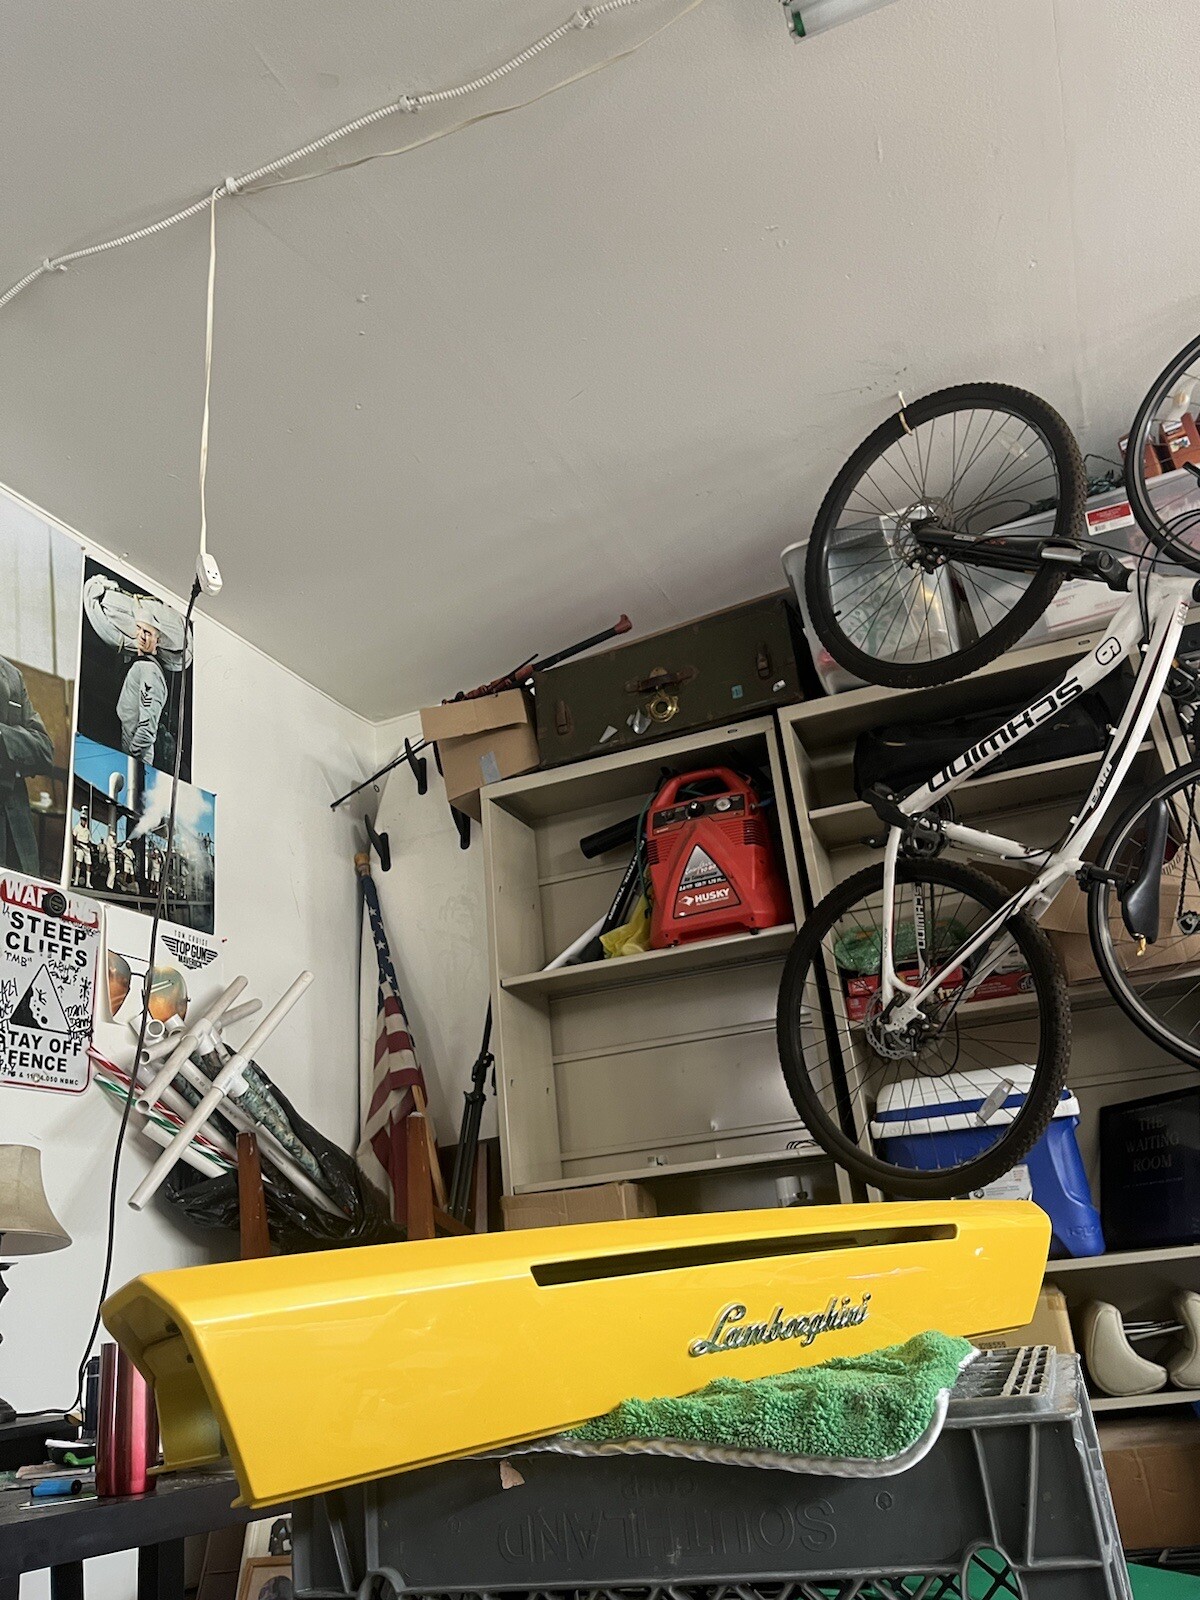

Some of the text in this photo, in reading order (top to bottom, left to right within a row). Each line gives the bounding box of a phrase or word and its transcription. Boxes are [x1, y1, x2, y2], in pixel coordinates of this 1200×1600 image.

[928, 676, 1083, 793] SCHWINN
[694, 888, 730, 903] HUSKY
[10, 911, 87, 946] STEEP
[175, 939, 207, 961] TOP GUN
[0, 1029, 82, 1057] TAY OFF
[8, 1049, 68, 1073] FENCE
[1139, 1115, 1166, 1131] THE
[1125, 1132, 1180, 1153] WAITING
[1133, 1154, 1172, 1172] ROOM
[688, 1293, 872, 1357] Lamborghini
[498, 1499, 839, 1565] SOUTHLAND
